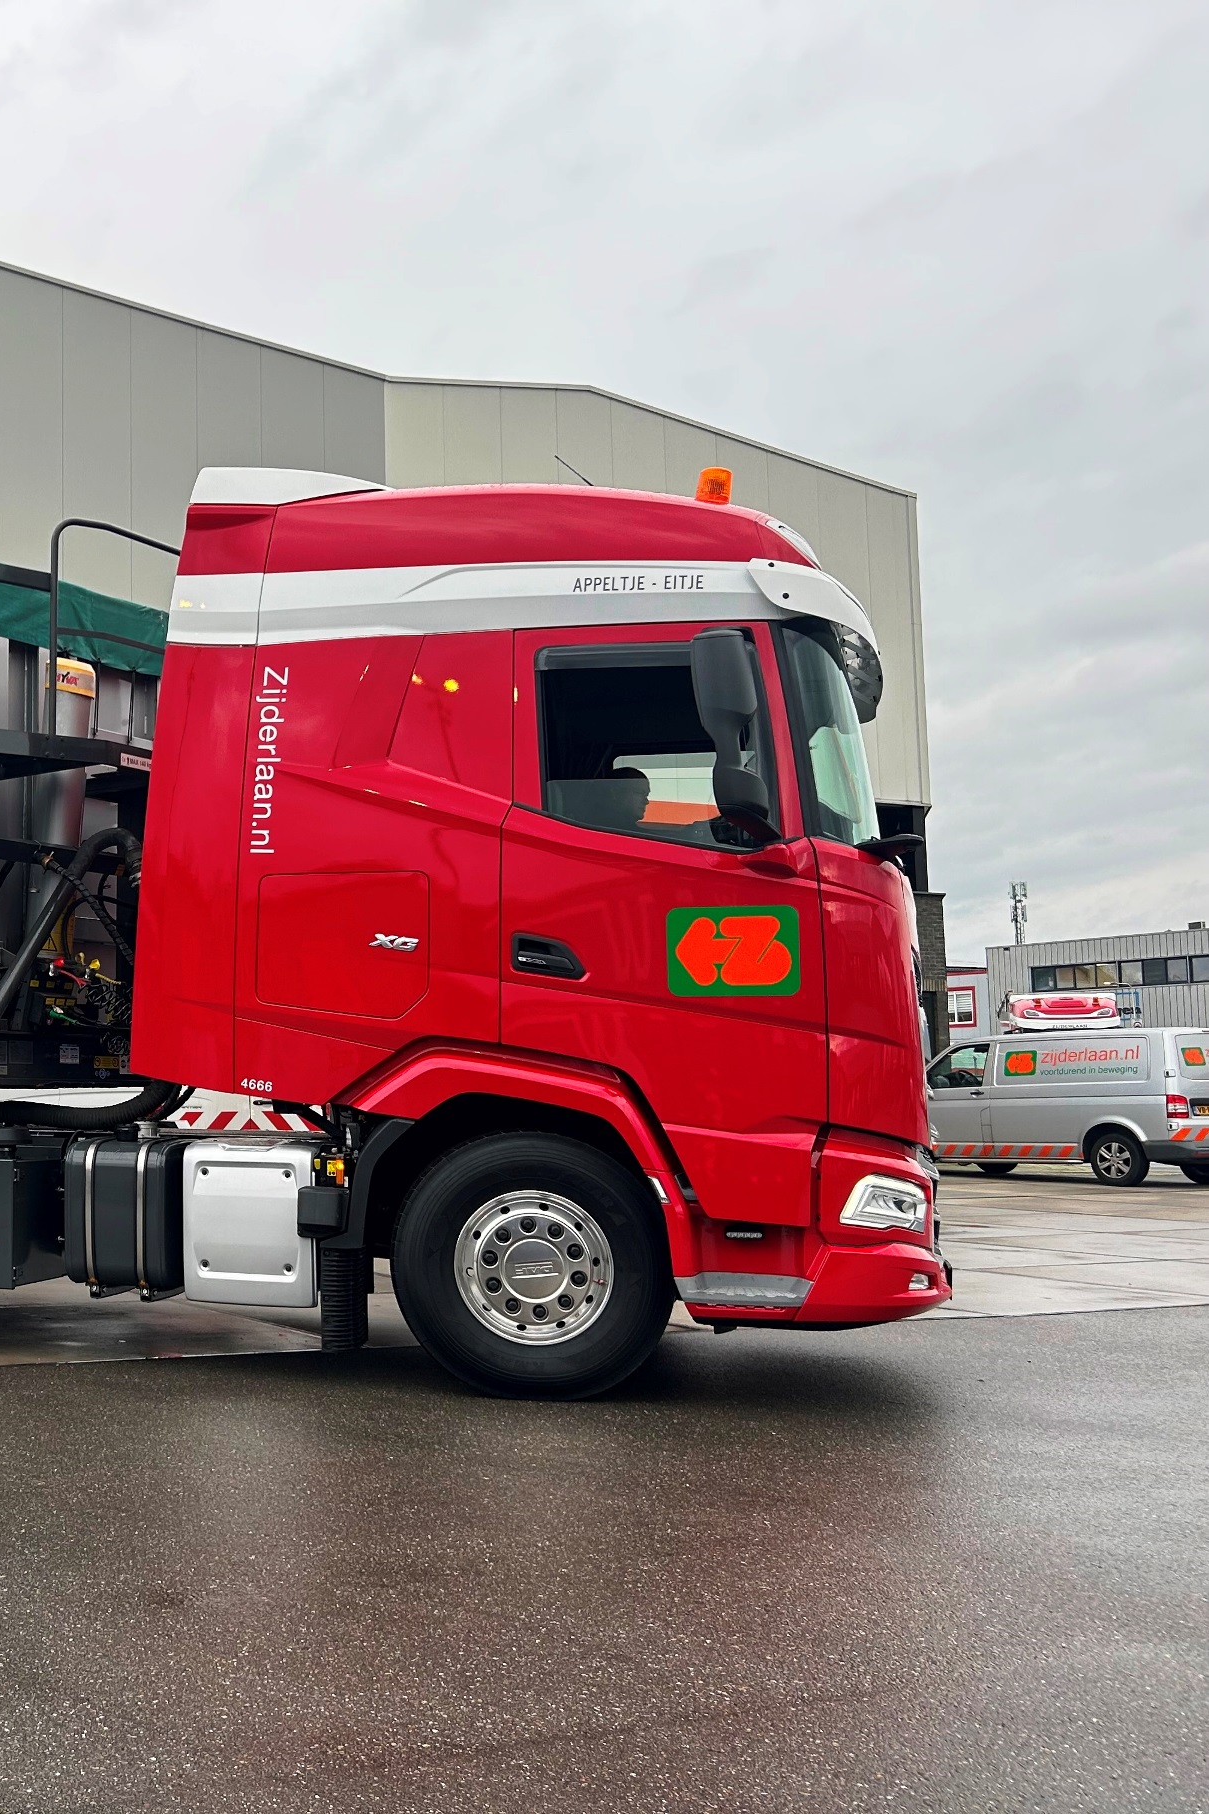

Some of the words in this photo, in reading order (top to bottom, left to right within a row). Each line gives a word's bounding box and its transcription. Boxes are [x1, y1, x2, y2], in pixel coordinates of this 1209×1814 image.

[572, 576, 645, 593] APPELTJE
[663, 574, 704, 590] EITJE
[249, 666, 290, 854] Zijderlaan.nl
[1040, 1045, 1140, 1067] zijderlaan.nl
[1039, 1067, 1087, 1076] voortdurend
[1088, 1066, 1096, 1074] in
[1097, 1065, 1139, 1075] beweging
[240, 1078, 273, 1092] 4666
